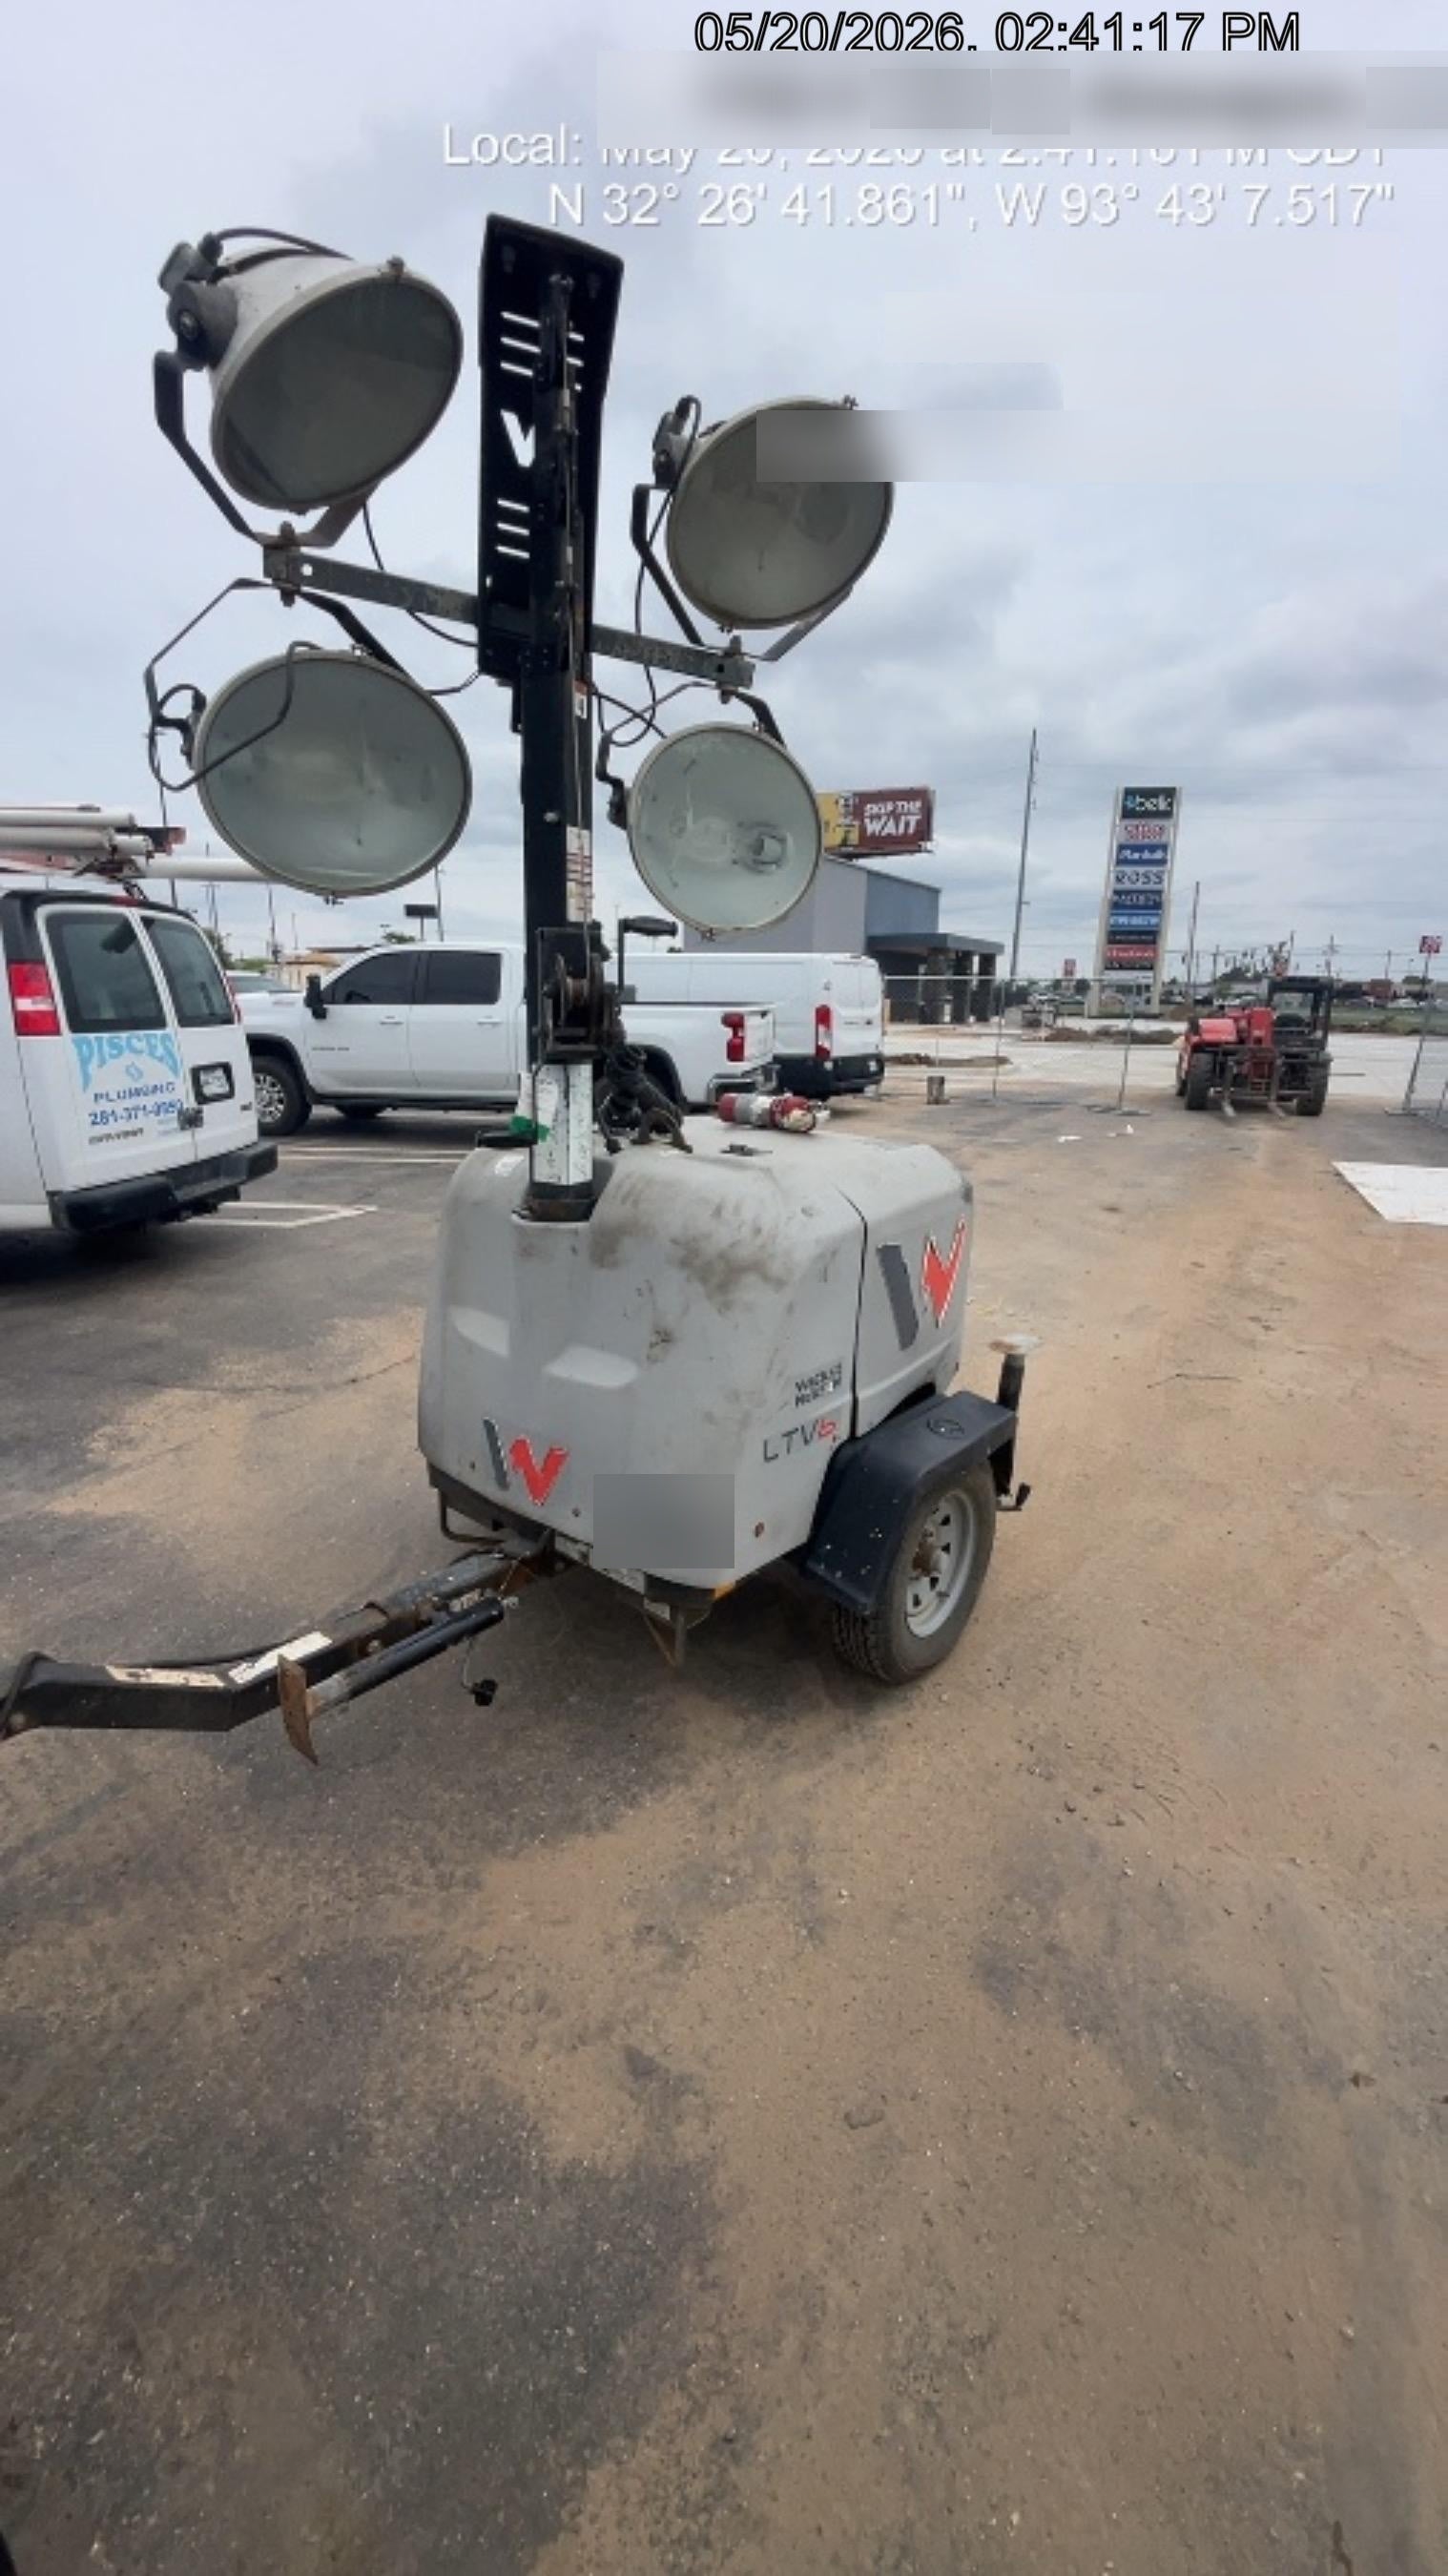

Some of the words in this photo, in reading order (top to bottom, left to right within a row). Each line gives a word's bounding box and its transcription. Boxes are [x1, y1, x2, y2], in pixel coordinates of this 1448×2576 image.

[896, 800, 922, 814] THE
[864, 815, 922, 837] WAIT
[1115, 869, 1165, 885] ROSS
[72, 1032, 179, 1093] PISCES
[93, 1082, 176, 1103] PLUMBING
